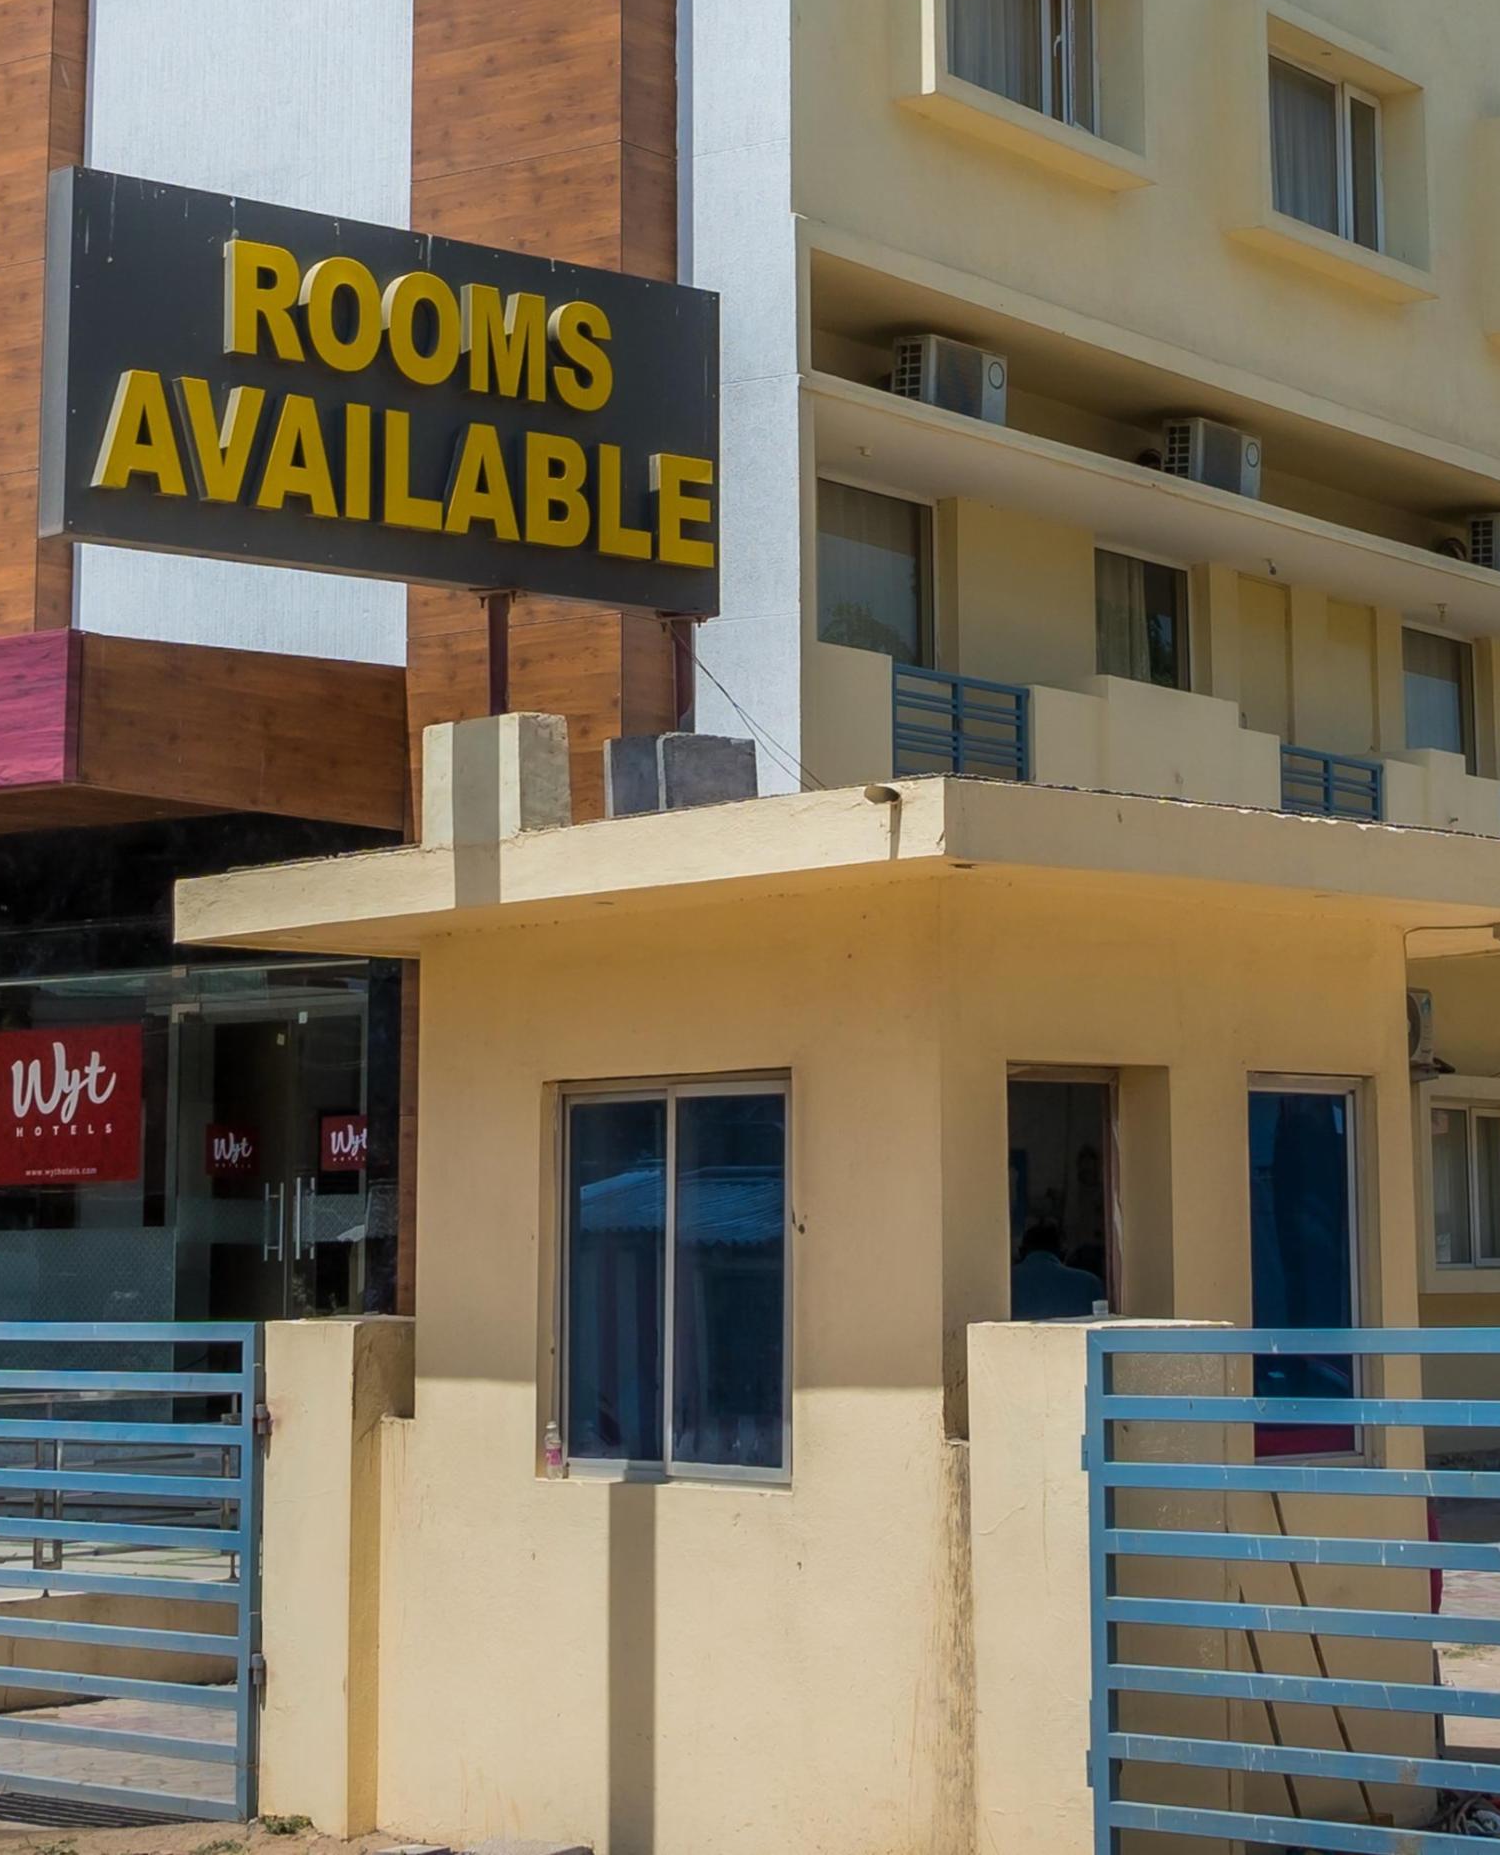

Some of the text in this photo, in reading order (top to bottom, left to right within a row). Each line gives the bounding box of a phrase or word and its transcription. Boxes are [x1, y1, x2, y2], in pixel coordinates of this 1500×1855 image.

[224, 238, 614, 412] ROOMS
[90, 369, 715, 568] AVAILABLE
[11, 1041, 117, 1124] Wyt
[15, 1123, 113, 1138] HOTELS
[212, 1131, 253, 1164] Wyt
